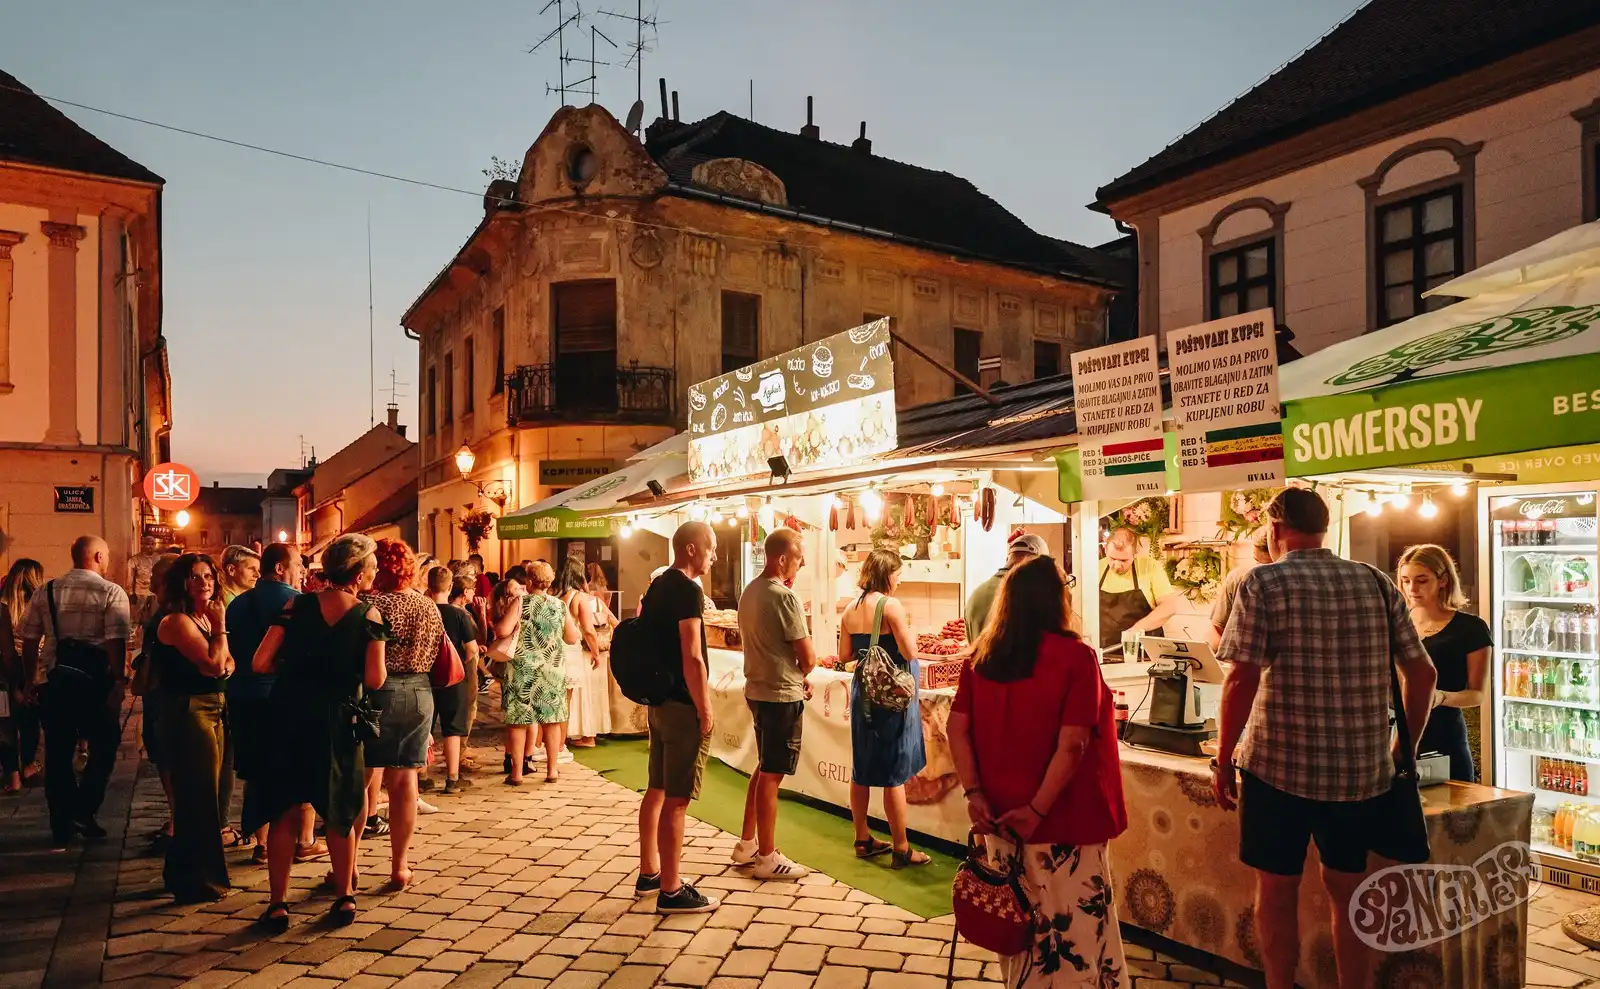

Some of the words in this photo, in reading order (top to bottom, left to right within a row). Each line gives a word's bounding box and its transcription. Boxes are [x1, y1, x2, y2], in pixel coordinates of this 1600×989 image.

[1176, 330, 1228, 355] POŠTOVANI
[1231, 321, 1264, 343] KUPCI
[1078, 354, 1121, 375] POŠTOVANI
[1122, 347, 1150, 366] KUPCI
[1176, 360, 1210, 376] MOLIMO
[1212, 356, 1228, 370] VAS
[1230, 354, 1242, 366] DA
[1244, 348, 1269, 364] PRVO
[1078, 380, 1106, 394] MOLIMO
[1108, 378, 1120, 389] VAS
[1122, 376, 1132, 387] DA
[1134, 372, 1154, 384] PRVO
[1174, 377, 1203, 392] OBAVITE
[1204, 370, 1241, 388] BLAGAJNU
[1242, 369, 1248, 380] A
[1249, 364, 1273, 378] ZATIM
[1077, 396, 1101, 409] OBAVITE
[1102, 390, 1132, 405] BLAGAJNU
[1132, 389, 1137, 400] A
[1138, 386, 1157, 398] ZATIM
[1180, 390, 1222, 408] STANETE
[1224, 389, 1231, 400] U
[1233, 385, 1254, 398] RED
[1256, 382, 1269, 395] ZA
[1082, 408, 1116, 422] STANETE
[1118, 406, 1123, 418] U
[1125, 404, 1142, 416] RED
[1144, 402, 1154, 414] ZA
[1186, 405, 1234, 422] KUPLJENU
[1236, 400, 1265, 414] ROBU
[1086, 422, 1127, 436] KUPLJENU
[1128, 417, 1151, 430] ROBU
[1292, 397, 1483, 463] SOMERSBY
[1180, 438, 1197, 446] RED
[1082, 450, 1096, 458] RED
[1182, 448, 1198, 456] RED
[1084, 459, 1096, 467] RED
[1084, 468, 1097, 476] RED
[1182, 458, 1198, 467] RED
[1136, 482, 1160, 491] HVALA
[1248, 472, 1276, 482] HVALA
[534, 516, 560, 533] SOMERSBY
